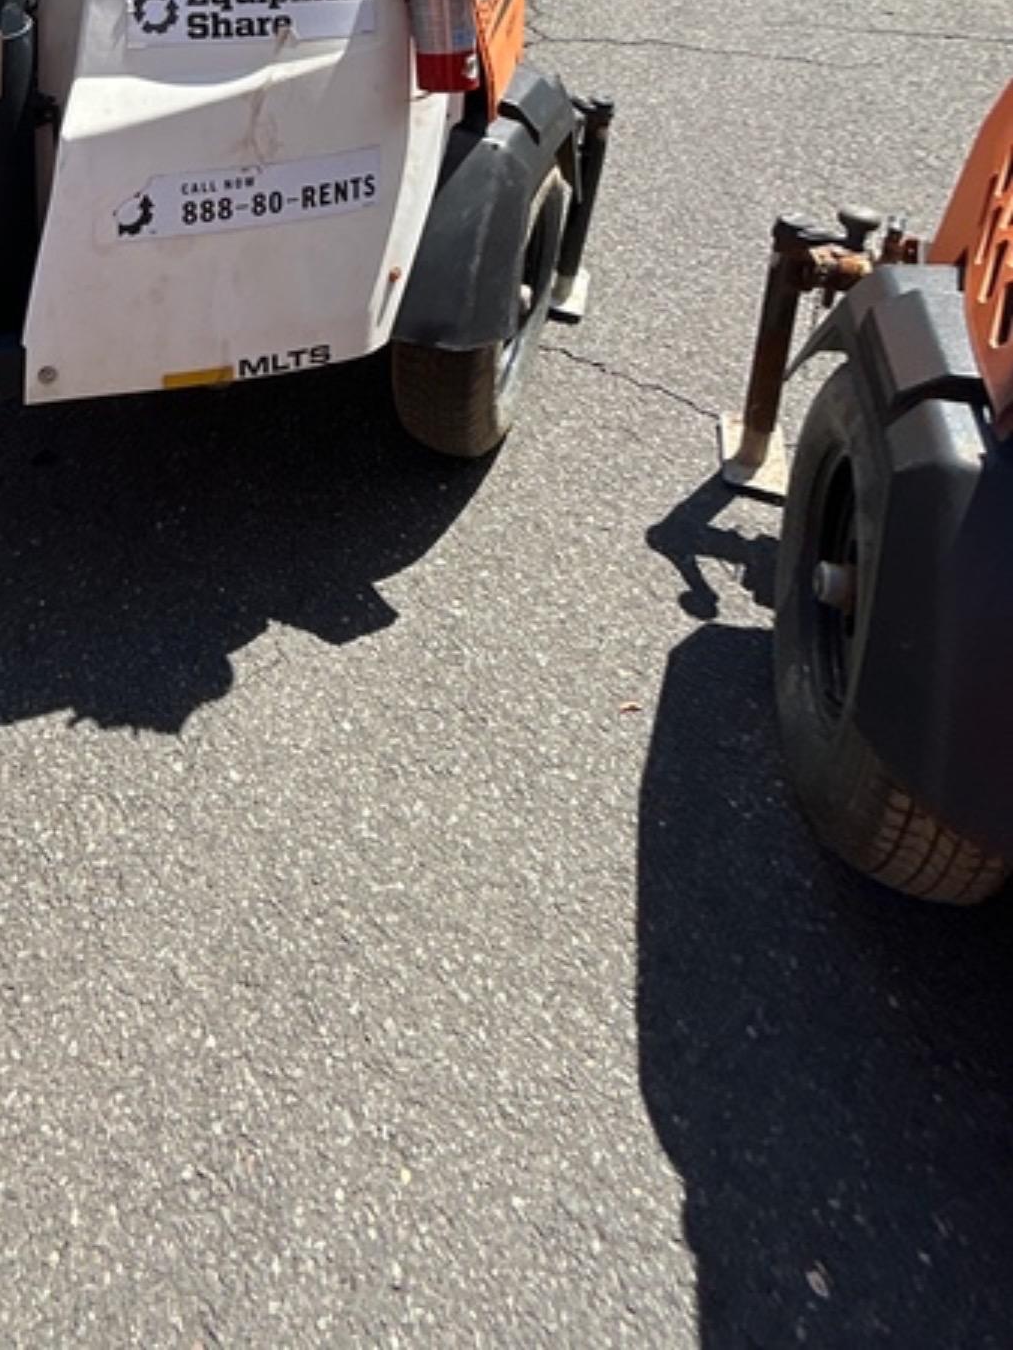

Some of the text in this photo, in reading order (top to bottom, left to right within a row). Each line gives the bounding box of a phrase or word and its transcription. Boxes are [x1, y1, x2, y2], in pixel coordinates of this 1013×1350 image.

[181, 180, 218, 196] CALL
[181, 174, 376, 226] 888-80-RENTS
[238, 344, 332, 377] MLTS
